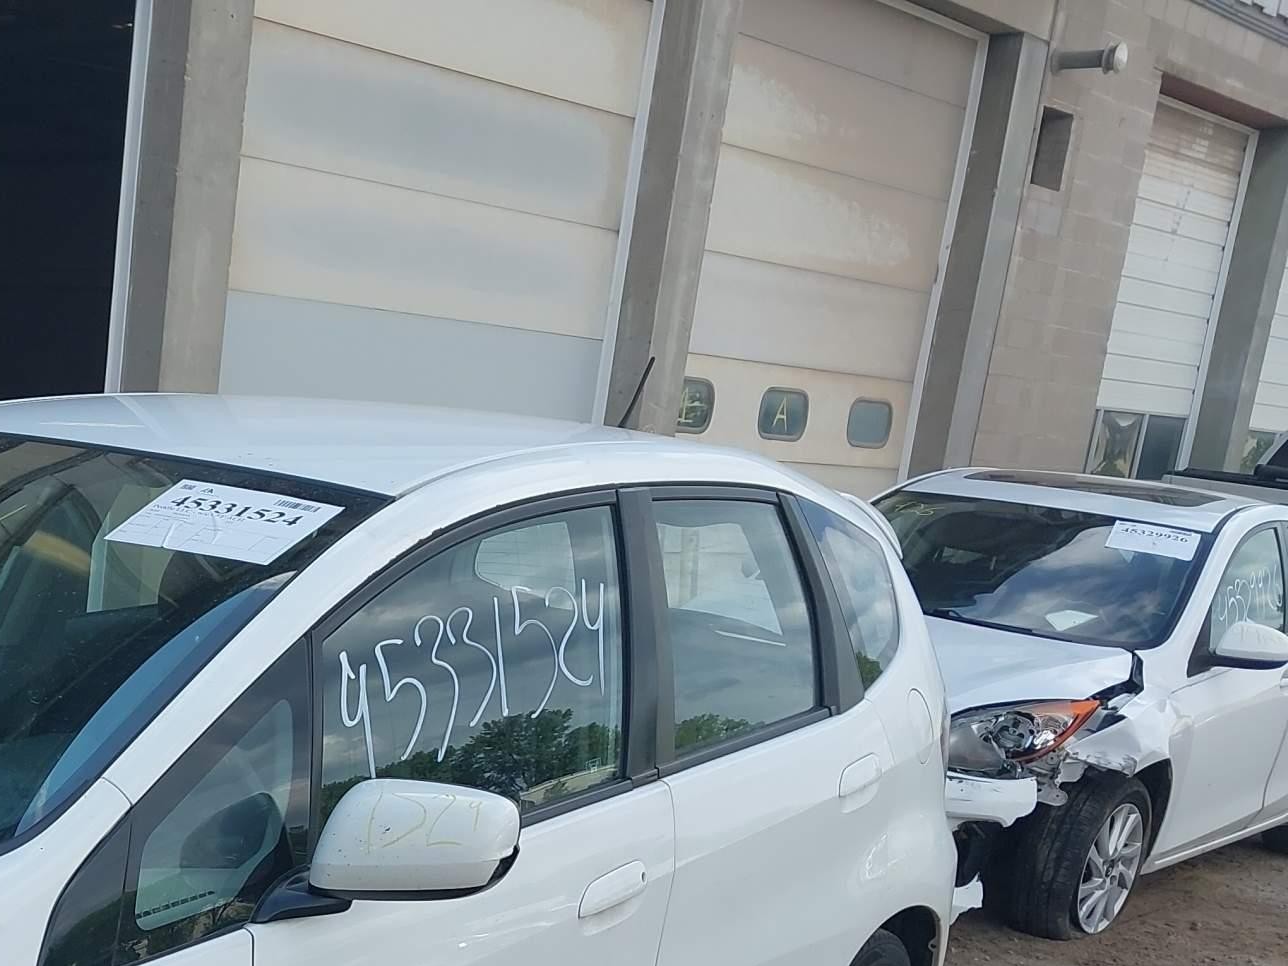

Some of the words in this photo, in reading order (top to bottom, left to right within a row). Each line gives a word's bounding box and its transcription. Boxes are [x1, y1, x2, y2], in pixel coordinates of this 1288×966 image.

[772, 397, 787, 433] A
[170, 495, 304, 527] 45331524
[339, 577, 605, 779] 45331524
